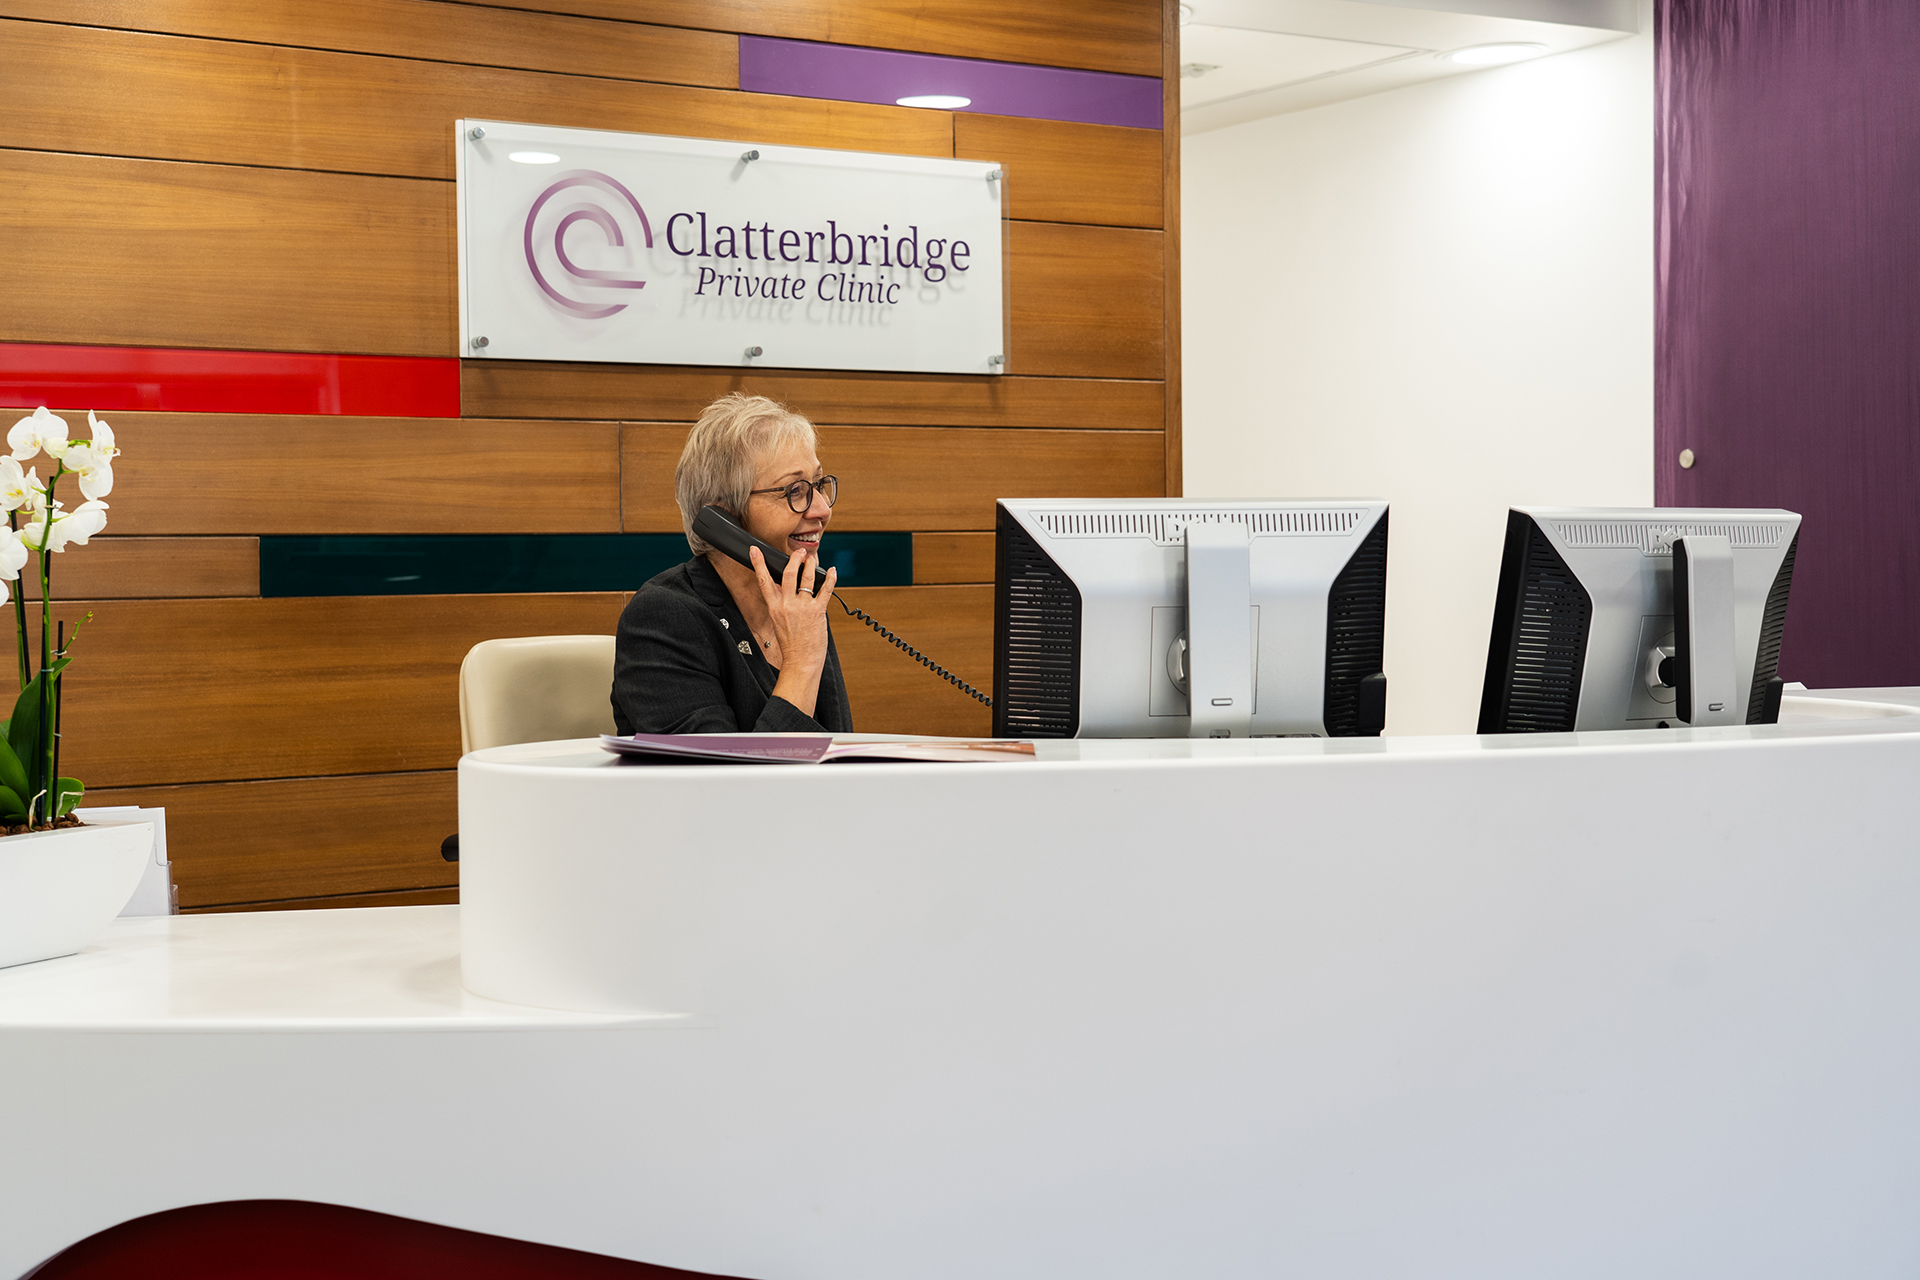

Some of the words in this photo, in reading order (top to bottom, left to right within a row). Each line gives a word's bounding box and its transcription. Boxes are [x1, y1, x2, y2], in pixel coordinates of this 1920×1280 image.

[666, 212, 971, 283] Clatterbridge
[695, 266, 806, 300] Private
[817, 272, 901, 304] Clinic
